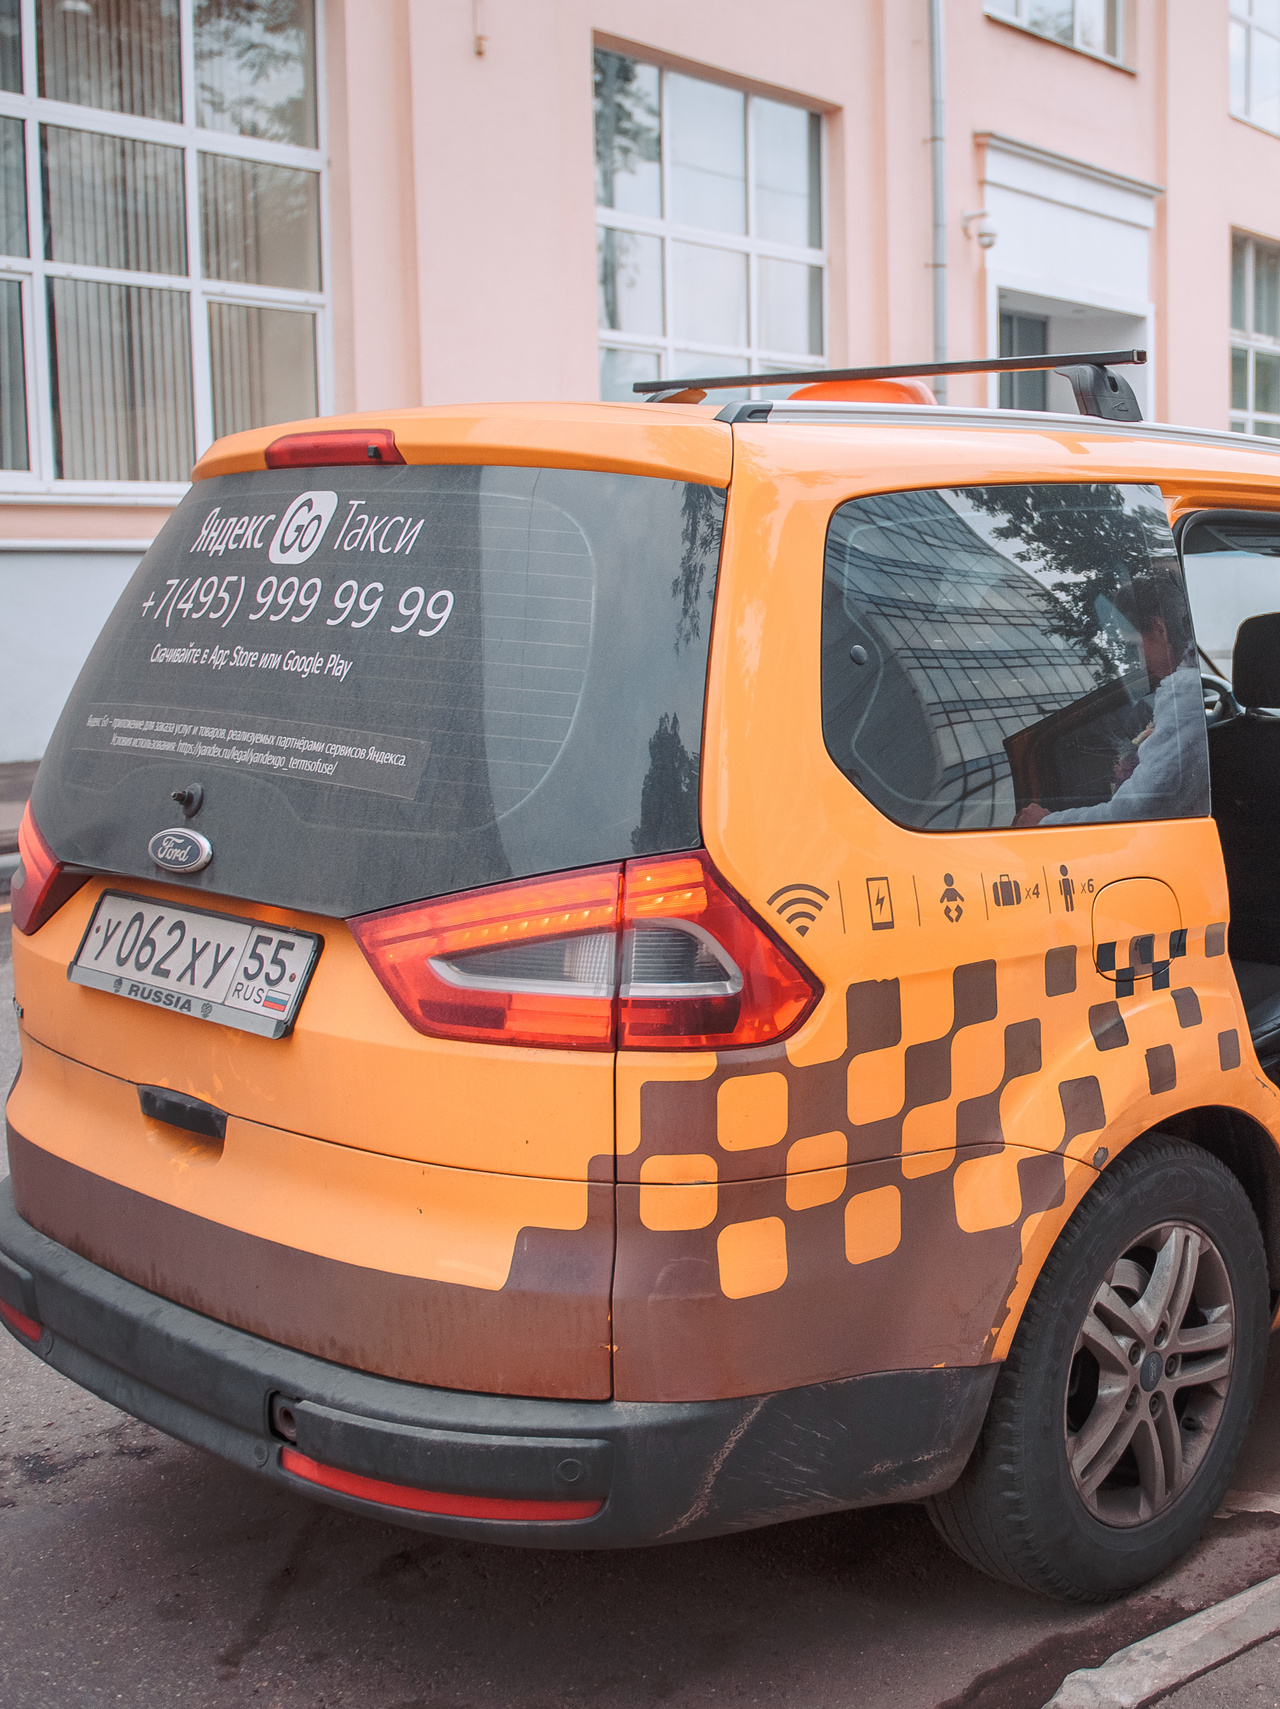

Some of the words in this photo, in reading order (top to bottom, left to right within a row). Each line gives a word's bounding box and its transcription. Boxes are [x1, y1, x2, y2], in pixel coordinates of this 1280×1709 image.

[189, 507, 276, 556] Яндекс
[277, 496, 325, 556] Go
[334, 500, 425, 555] Такси
[141, 576, 246, 628] +7(495)
[249, 576, 322, 623] 999
[326, 580, 384, 628] 99
[390, 586, 455, 637] 99
[150, 642, 201, 664] Скачивайте
[201, 651, 208, 664] в
[208, 645, 229, 670] App
[229, 646, 259, 668] Store
[258, 653, 281, 670] или
[282, 650, 324, 678] Google
[324, 654, 353, 682] Play
[154, 721, 174, 733] заказа
[173, 724, 194, 737] услуг
[192, 726, 199, 735] и
[226, 728, 276, 746] реализуемых
[275, 734, 325, 752] партнёрами
[325, 741, 366, 760] сервисов
[365, 745, 407, 767] Яндекса.
[157, 836, 192, 863] Ford
[243, 935, 296, 987] 55
[127, 983, 193, 1013] RUSSIA
[231, 982, 265, 1005] RUS
